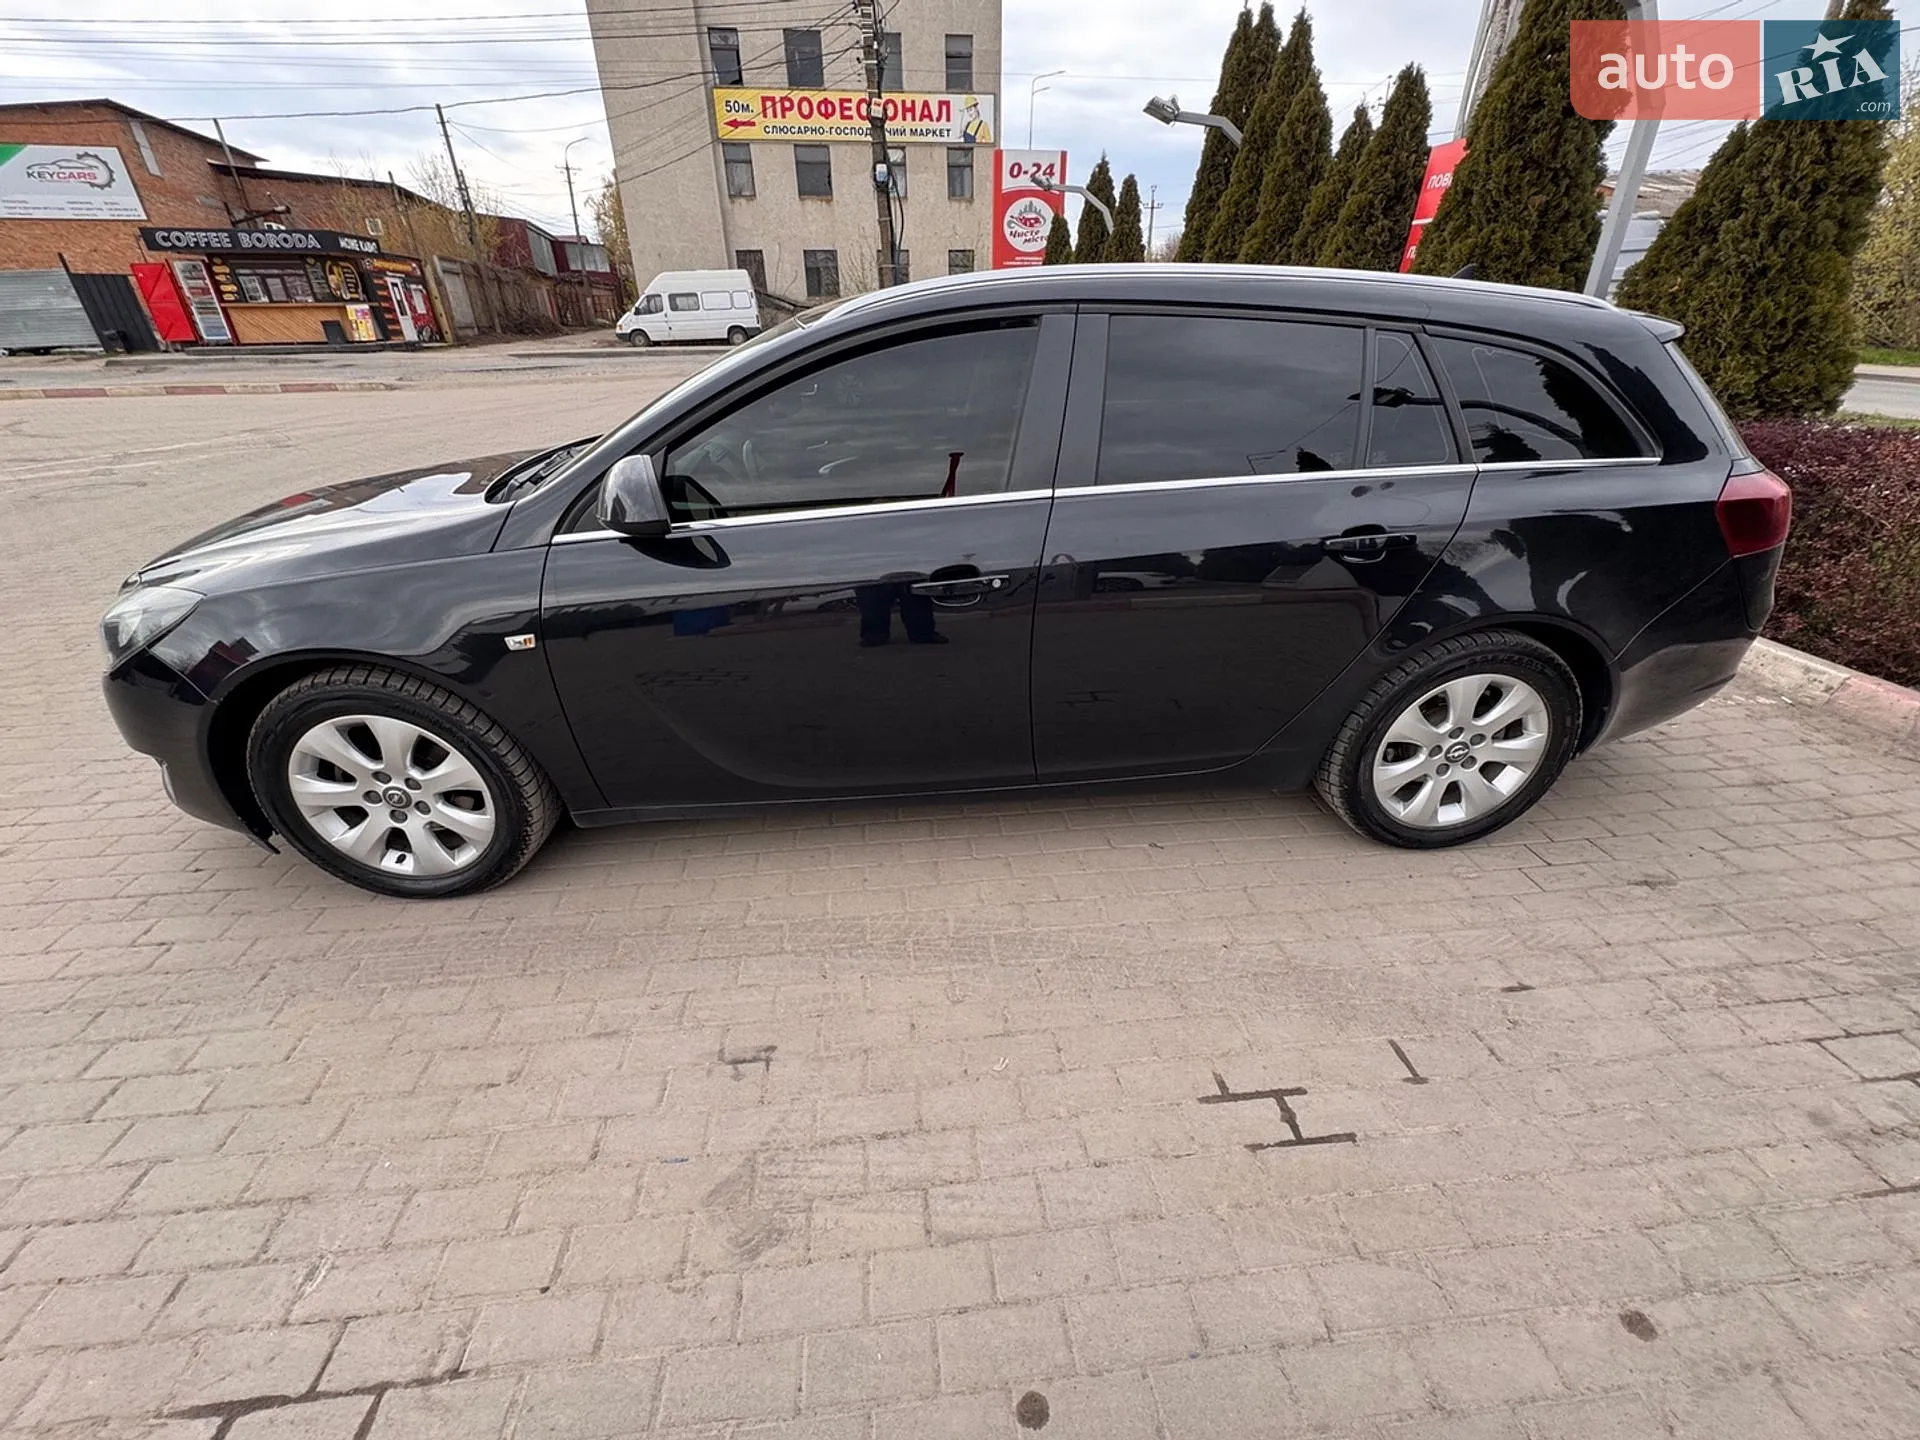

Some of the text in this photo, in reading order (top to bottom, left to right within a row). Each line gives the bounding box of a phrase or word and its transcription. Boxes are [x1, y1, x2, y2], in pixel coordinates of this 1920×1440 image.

[725, 100, 754, 114] 50м.
[760, 95, 951, 123] ПРОФЕСОНАЛ
[763, 125, 952, 138] СЛЮСАРНО-ГОСПОДЧИЙ МАРКЕТ
[26, 170, 97, 180] KEYCARS
[1009, 161, 1056, 179] 0-24
[155, 230, 321, 249] COFFEE BORODA
